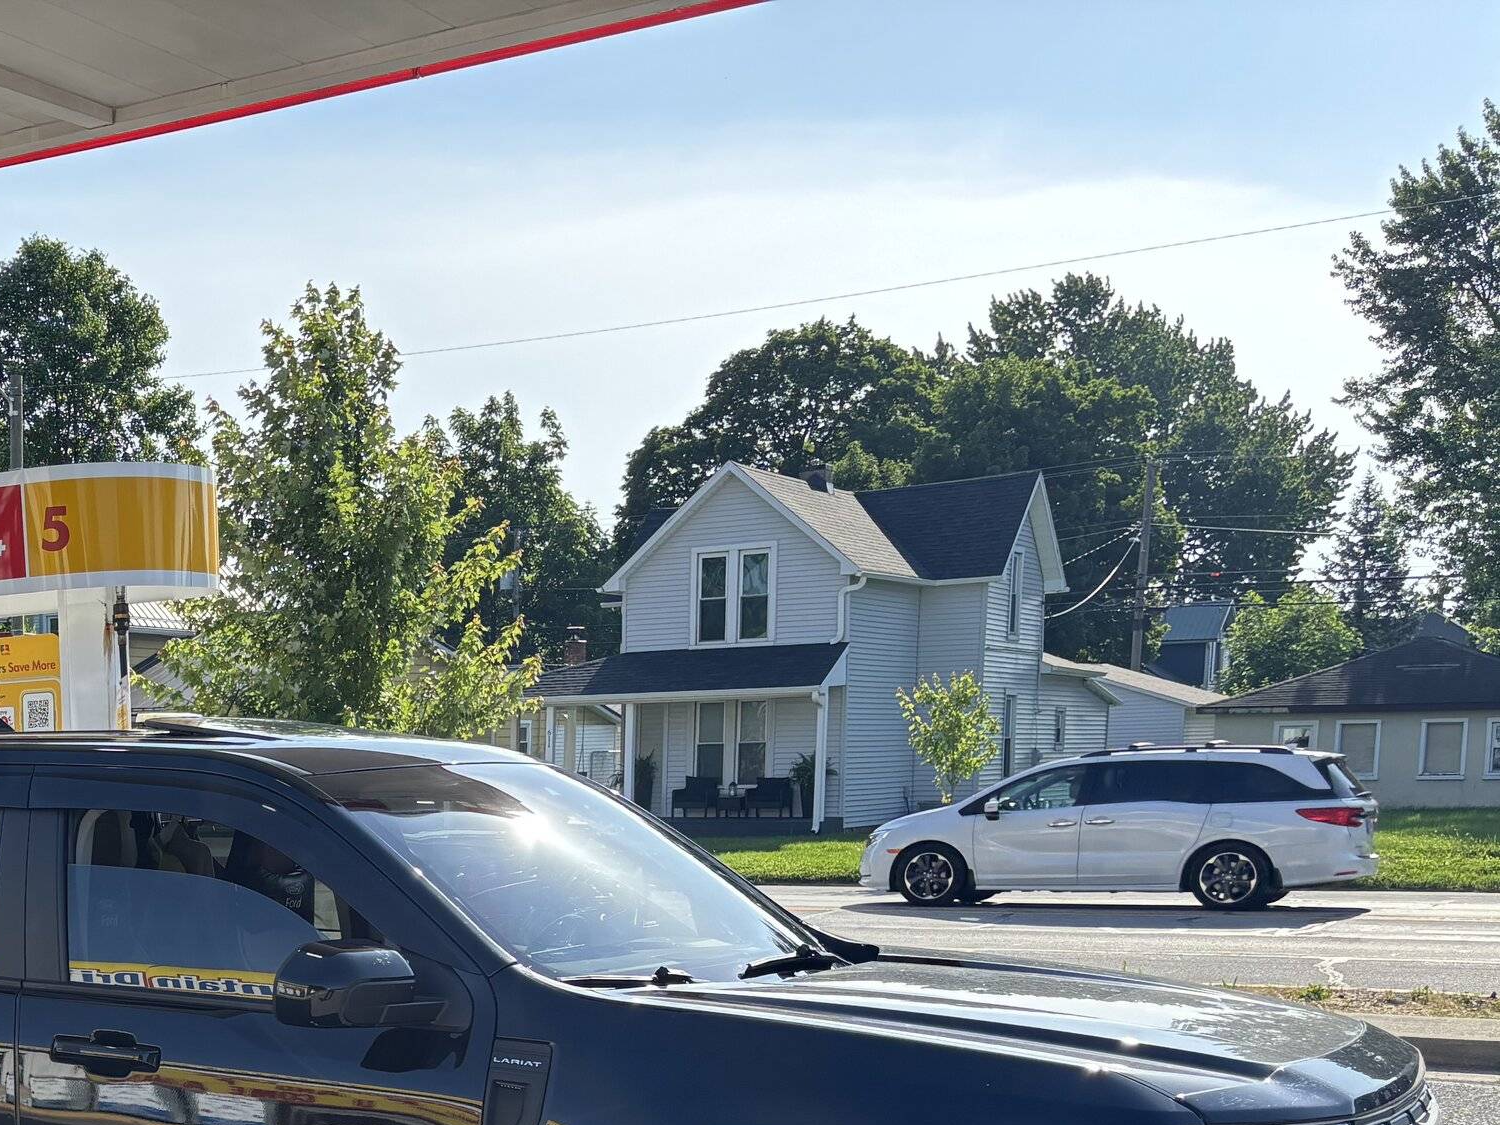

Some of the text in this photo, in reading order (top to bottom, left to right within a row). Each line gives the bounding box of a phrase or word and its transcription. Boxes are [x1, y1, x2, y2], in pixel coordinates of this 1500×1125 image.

[41, 505, 71, 552] 5
[7, 661, 30, 673] Save
[31, 660, 57, 671] More
[493, 1056, 542, 1068] LARIAT
